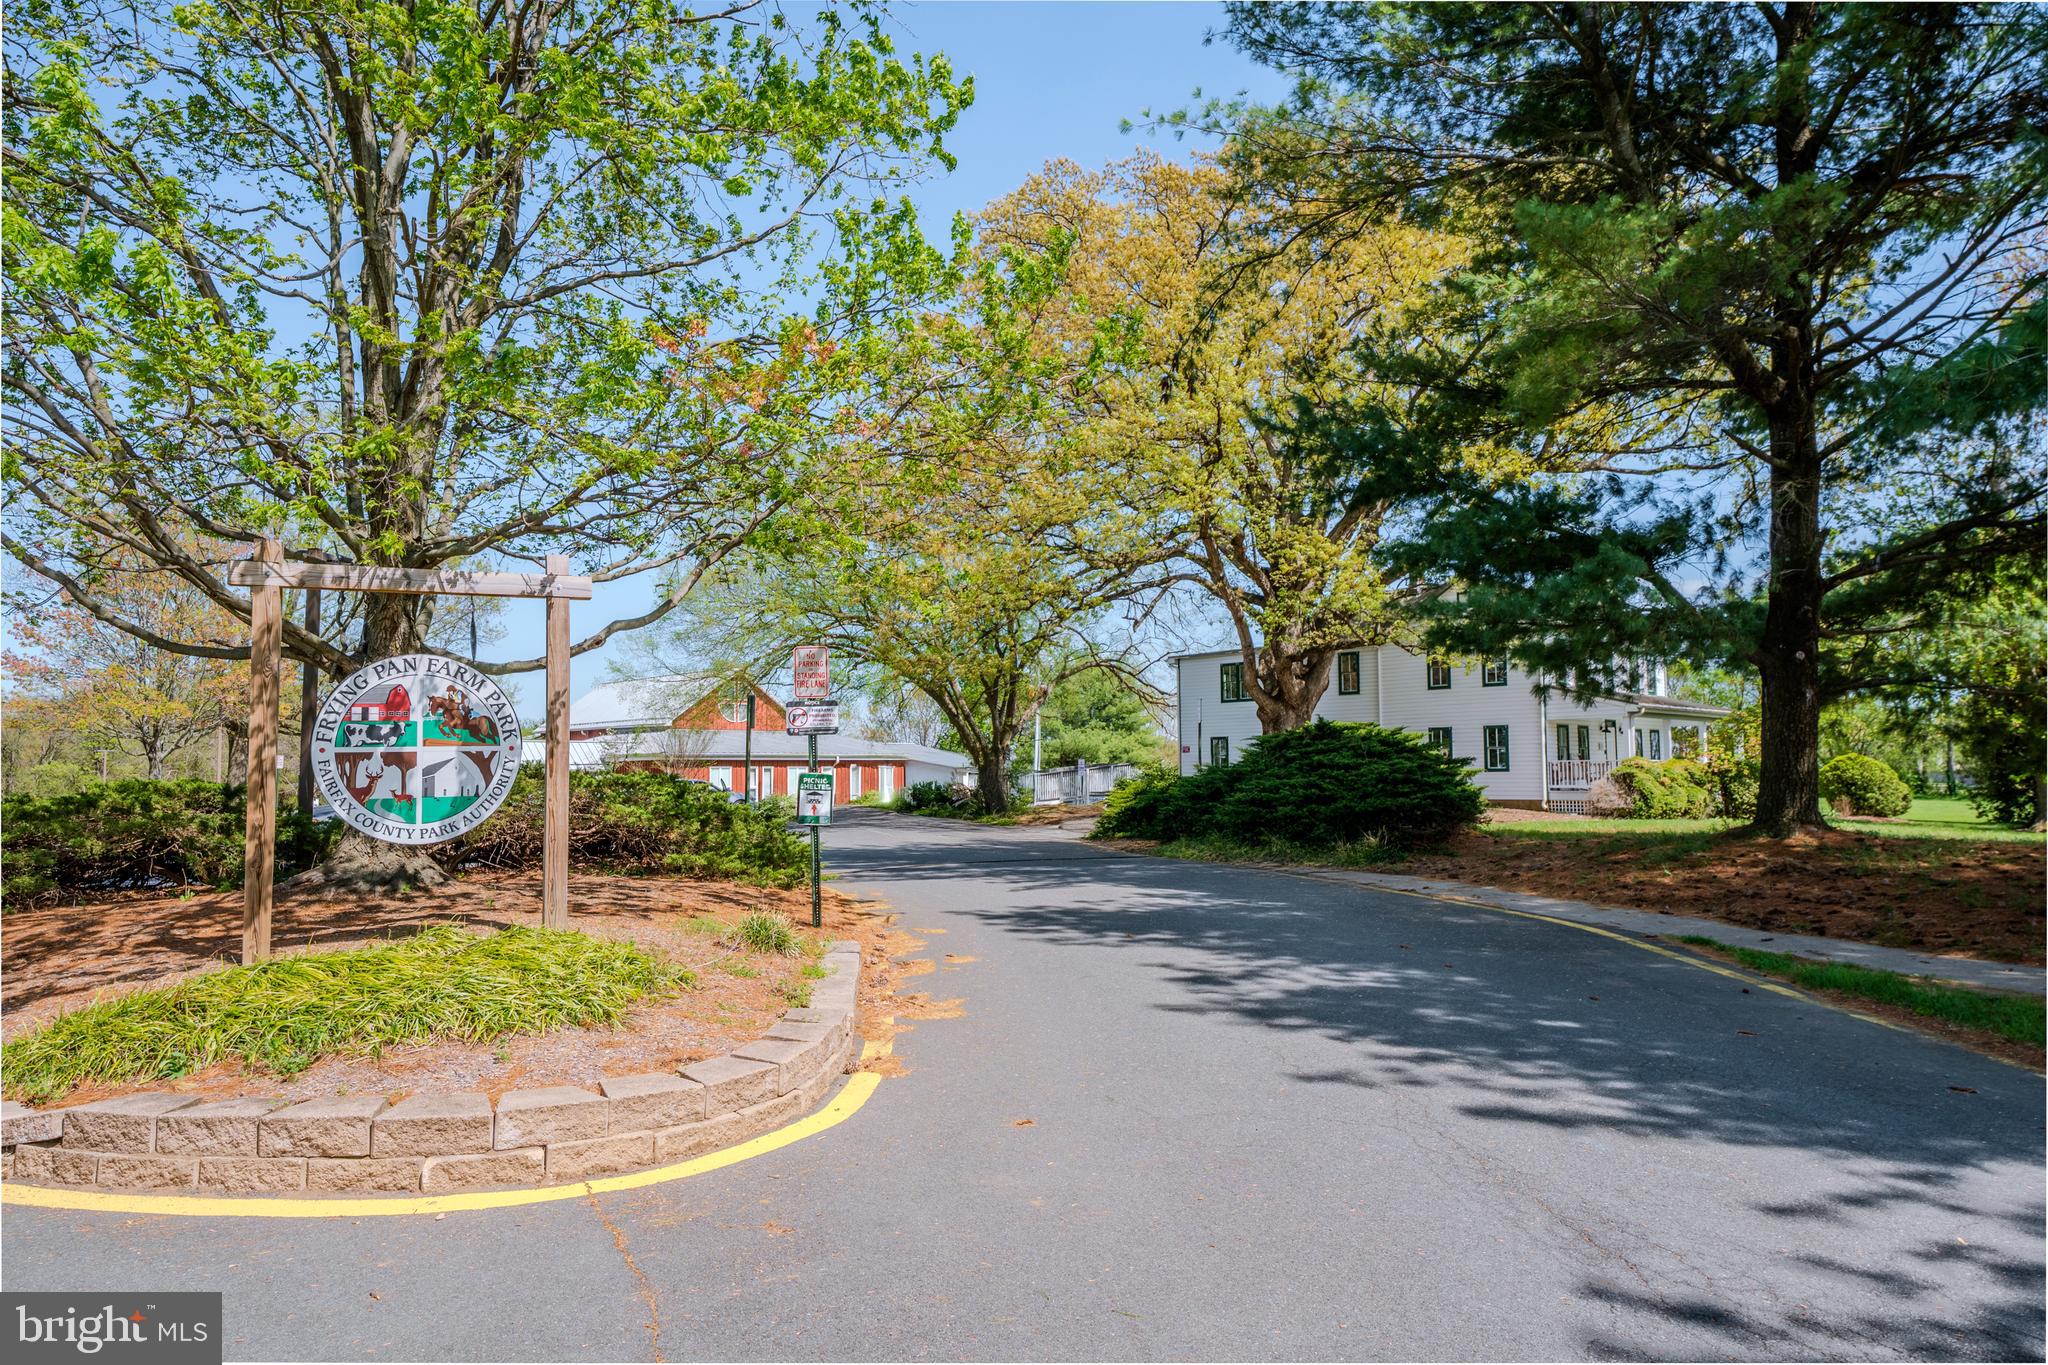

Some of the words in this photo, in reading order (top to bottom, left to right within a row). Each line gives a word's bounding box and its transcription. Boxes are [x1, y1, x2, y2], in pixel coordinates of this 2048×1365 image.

[316, 674, 369, 743] FRYING
[372, 657, 417, 680] PAN
[427, 657, 486, 692] FARM
[485, 691, 518, 741] PARK
[796, 680, 809, 688] FIRE
[811, 680, 825, 688] LANE
[318, 759, 357, 815] FAIRFAX
[354, 812, 415, 839] COUNTY
[420, 822, 461, 838] PARK
[463, 756, 516, 827] AUTHORITY
